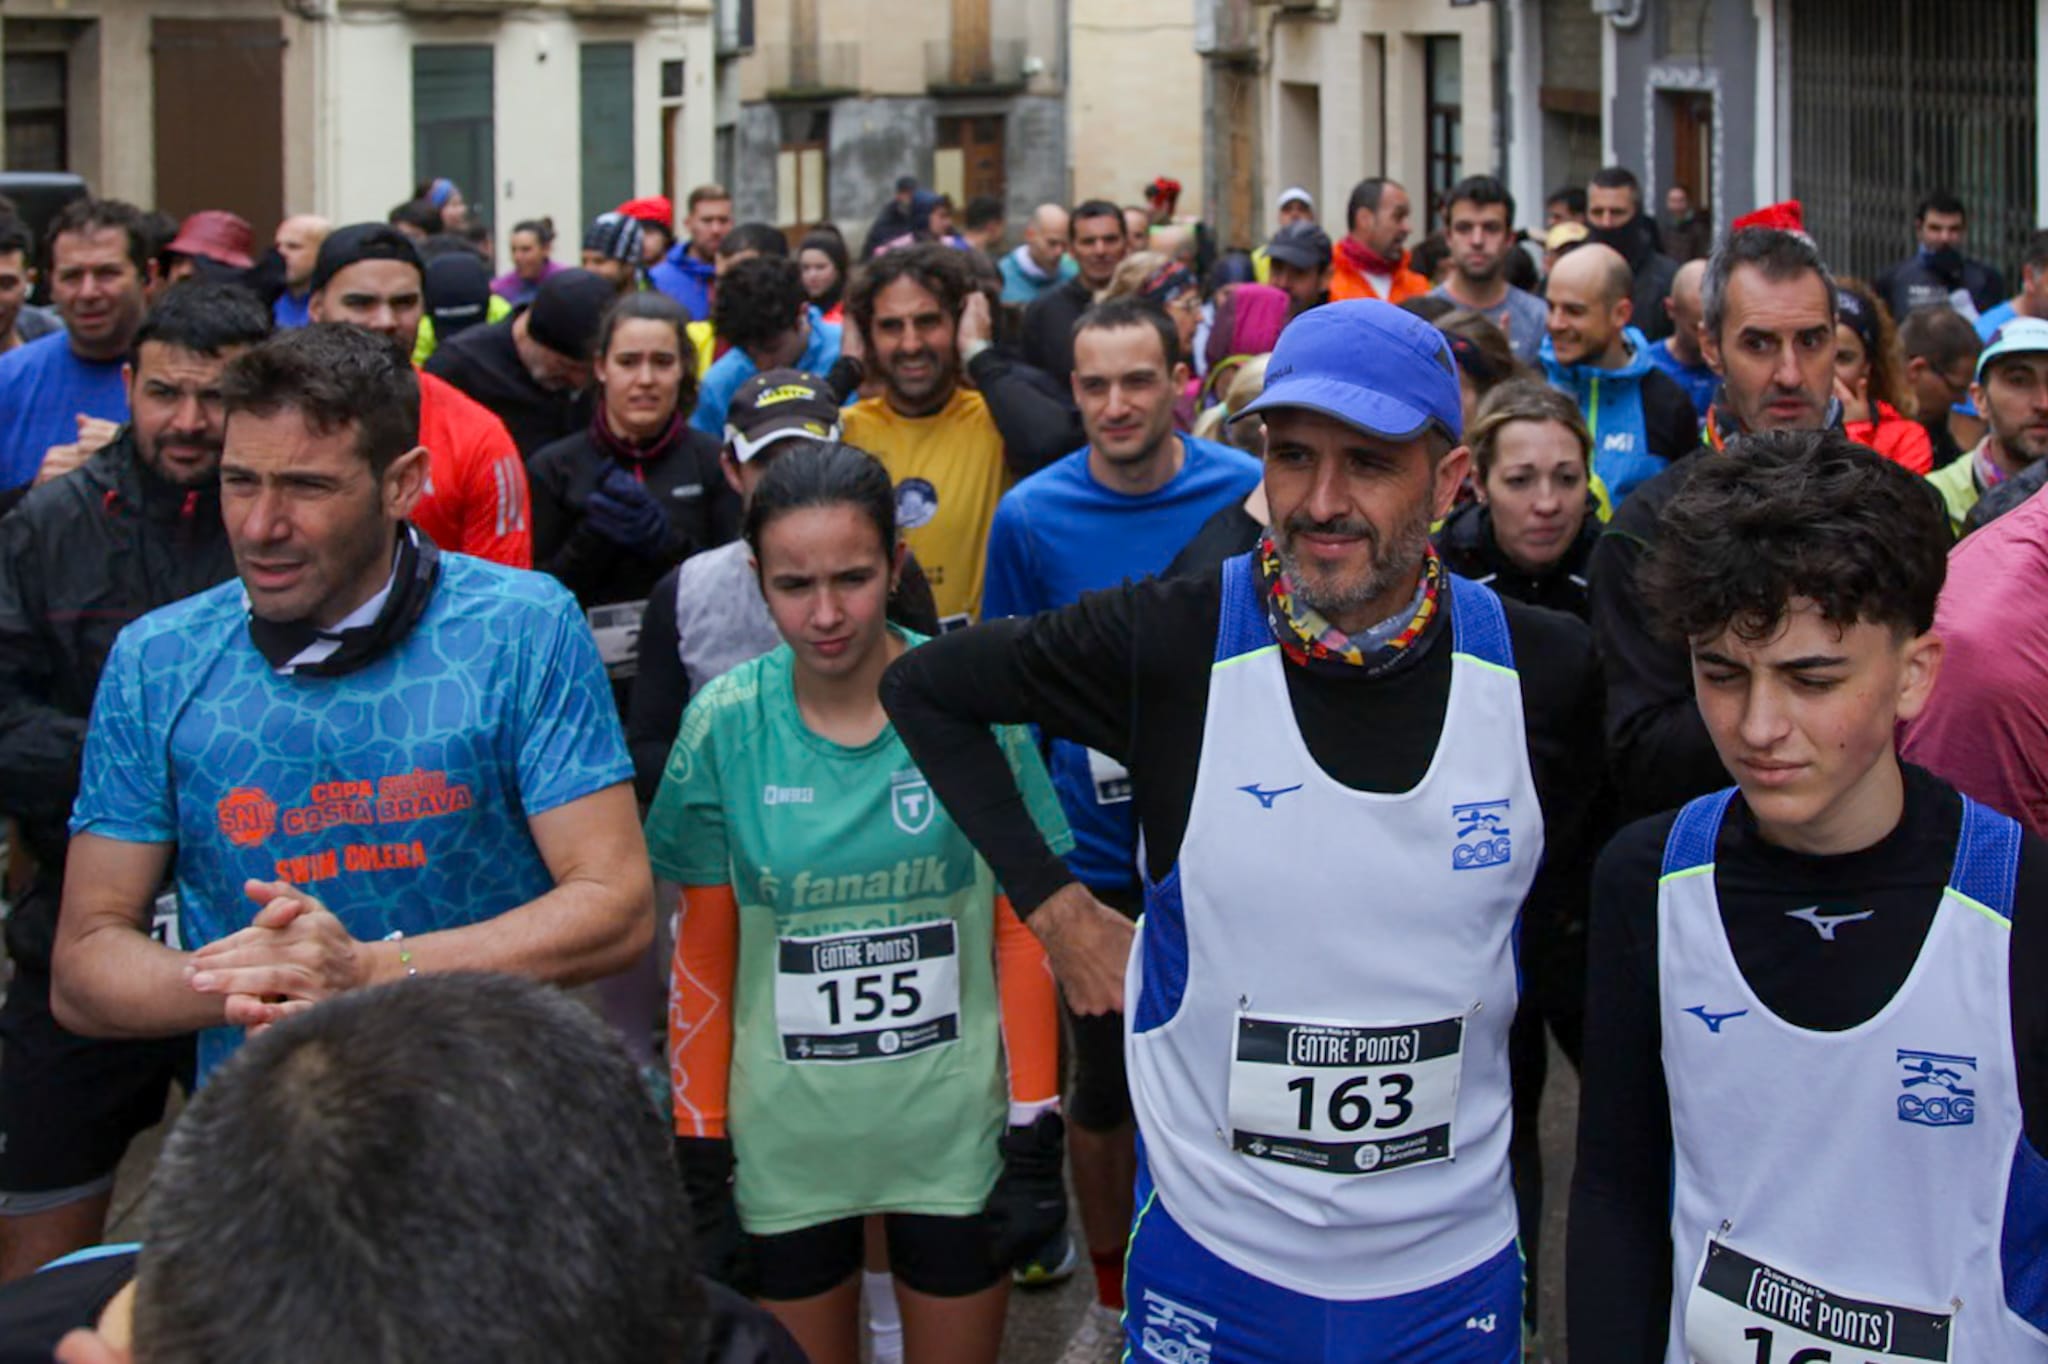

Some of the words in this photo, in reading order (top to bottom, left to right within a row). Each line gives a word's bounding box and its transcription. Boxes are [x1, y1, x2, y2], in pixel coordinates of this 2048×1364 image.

[284, 802, 373, 835] COSTA
[377, 785, 472, 823] BRAVA
[310, 779, 373, 803] COPA
[275, 849, 338, 883] SWIM
[791, 856, 948, 906] fanatik
[817, 969, 922, 1025] 155
[1297, 1035, 1350, 1063] ENTRE
[1355, 1034, 1411, 1063] PONTS
[1287, 1072, 1414, 1132] 163
[1756, 1278, 1813, 1328] ENTRE
[1817, 1302, 1882, 1346] PONTS
